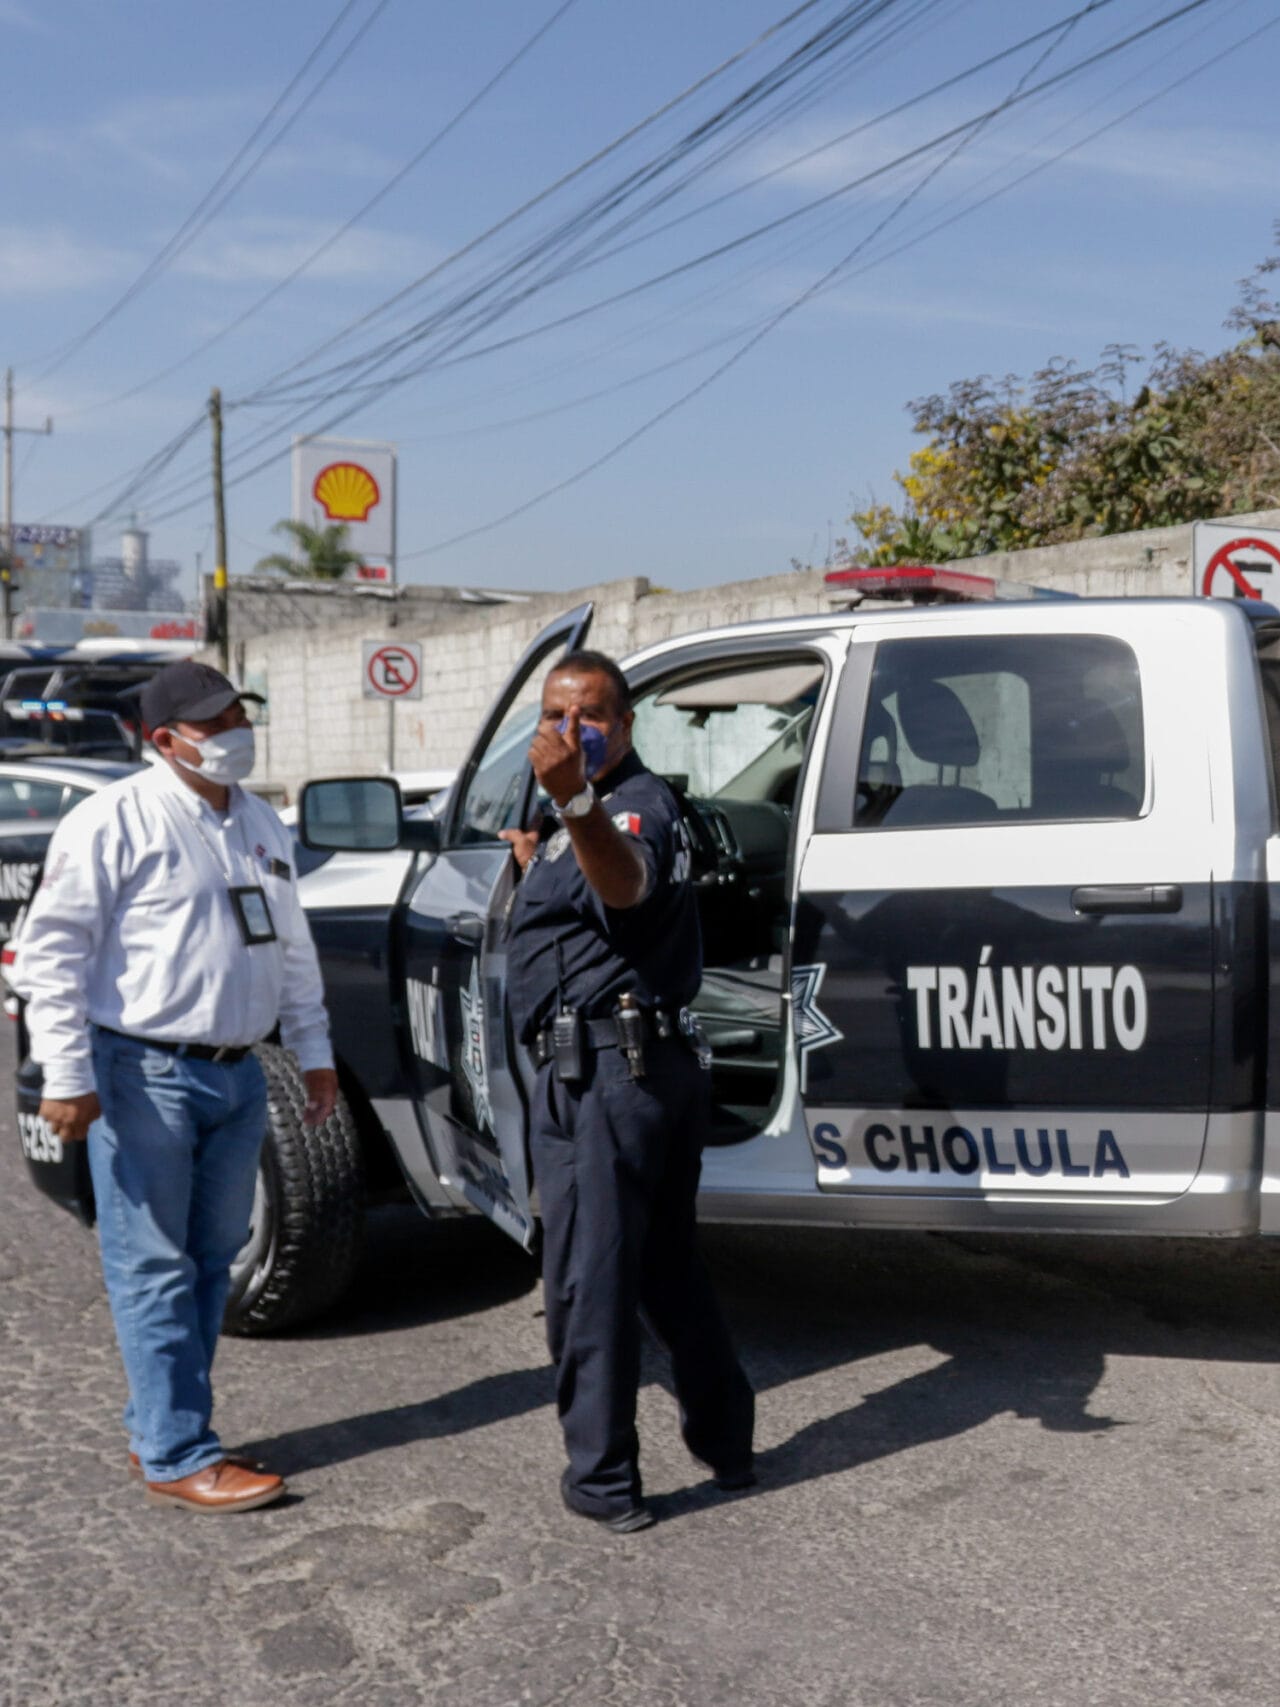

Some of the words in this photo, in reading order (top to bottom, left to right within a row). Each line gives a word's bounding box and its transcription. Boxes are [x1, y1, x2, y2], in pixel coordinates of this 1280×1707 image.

[906, 945, 1147, 1051] TRÁNSITO
[813, 1122, 847, 1169] S
[864, 1123, 1130, 1178] CHOLULA
